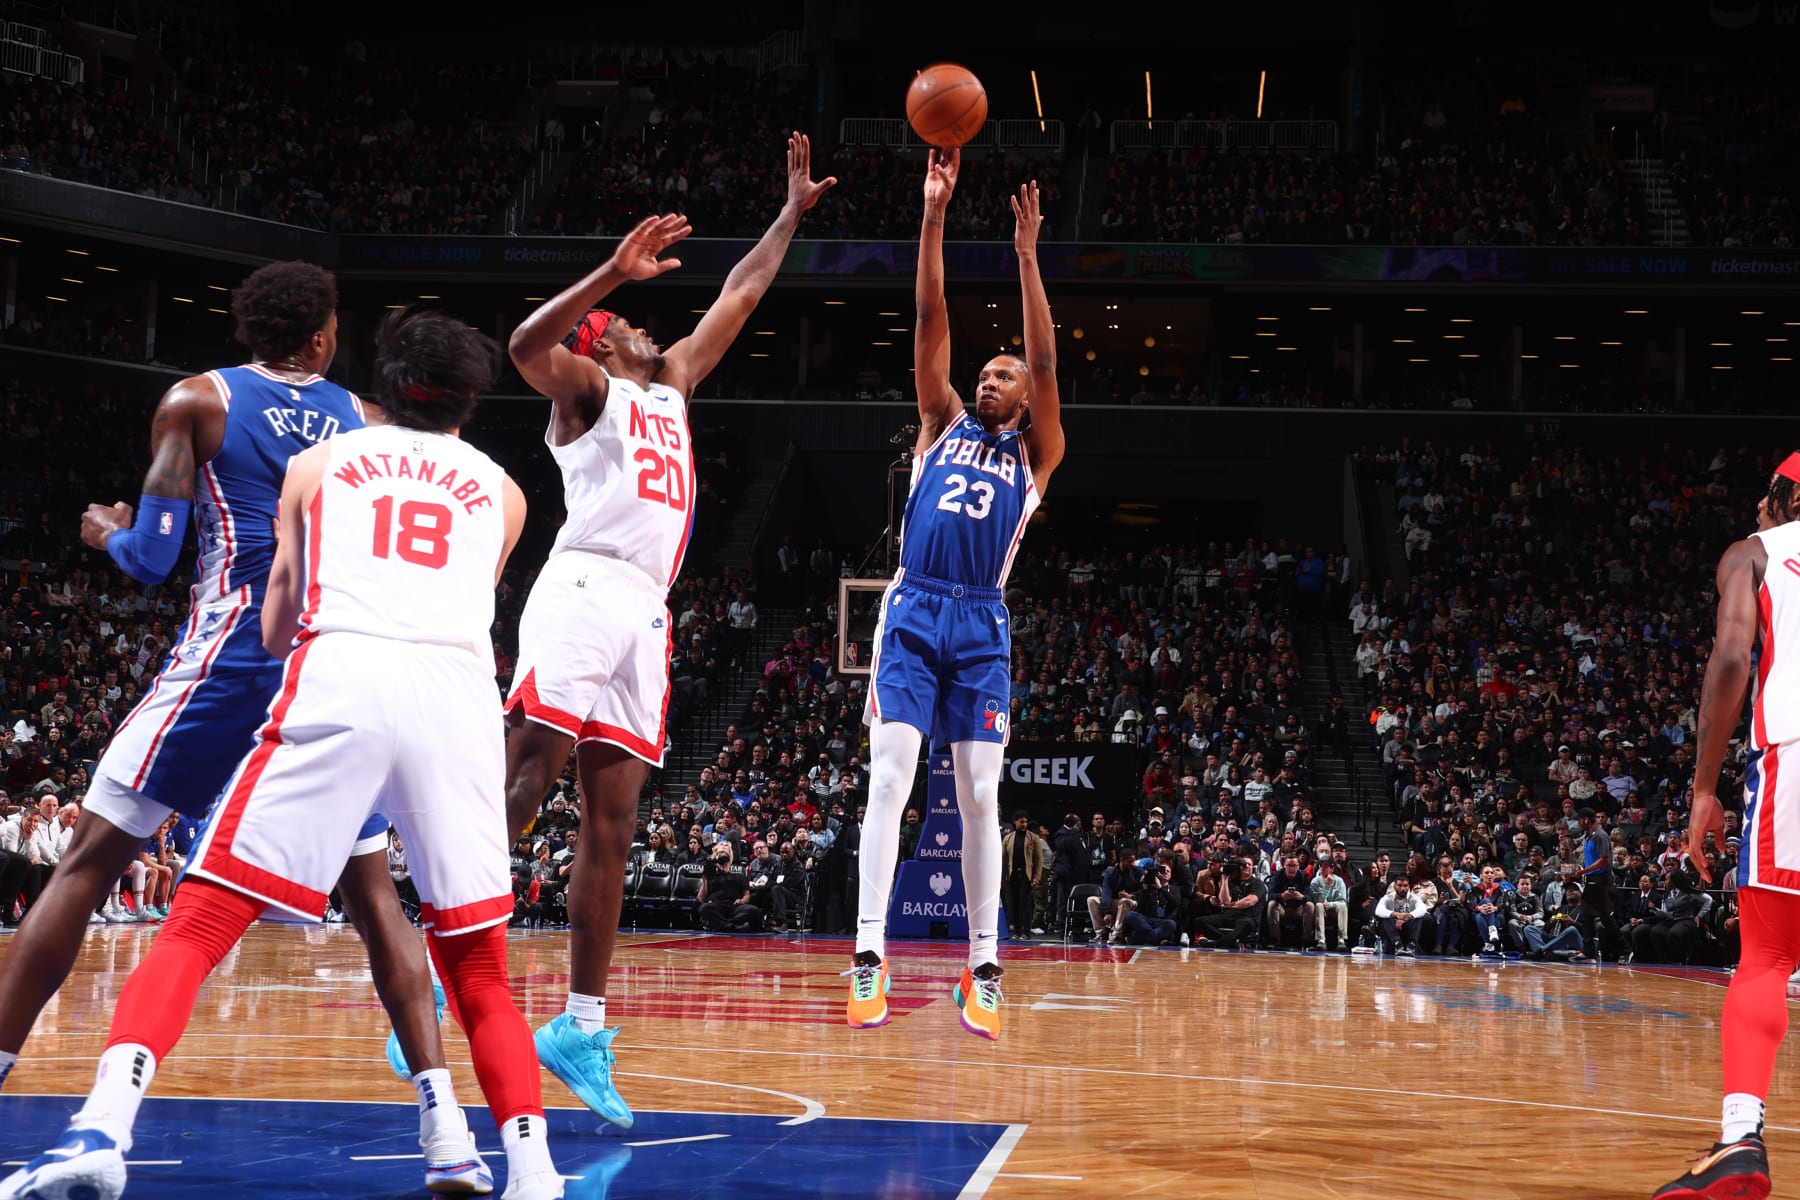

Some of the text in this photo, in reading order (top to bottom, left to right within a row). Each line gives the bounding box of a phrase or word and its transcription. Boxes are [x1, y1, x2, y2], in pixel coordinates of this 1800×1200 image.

[389, 247, 432, 261] SALE
[439, 247, 481, 262] NOW
[503, 246, 600, 263] ticketmaster
[1135, 256, 1193, 273] TRUCKS
[1551, 256, 1577, 273] ON
[1583, 256, 1633, 273] SALE
[1639, 256, 1688, 273] NOW
[629, 400, 681, 451] NTS
[633, 447, 686, 512] 20
[935, 438, 1017, 488] PHILA
[334, 454, 493, 515] WATANABE
[937, 473, 996, 520] 23
[372, 494, 453, 570] 18
[983, 710, 1006, 734] 76
[1000, 755, 1096, 790] TGEEK
[930, 807, 958, 815] BARCLAYS
[902, 902, 968, 917] BARCLAY
